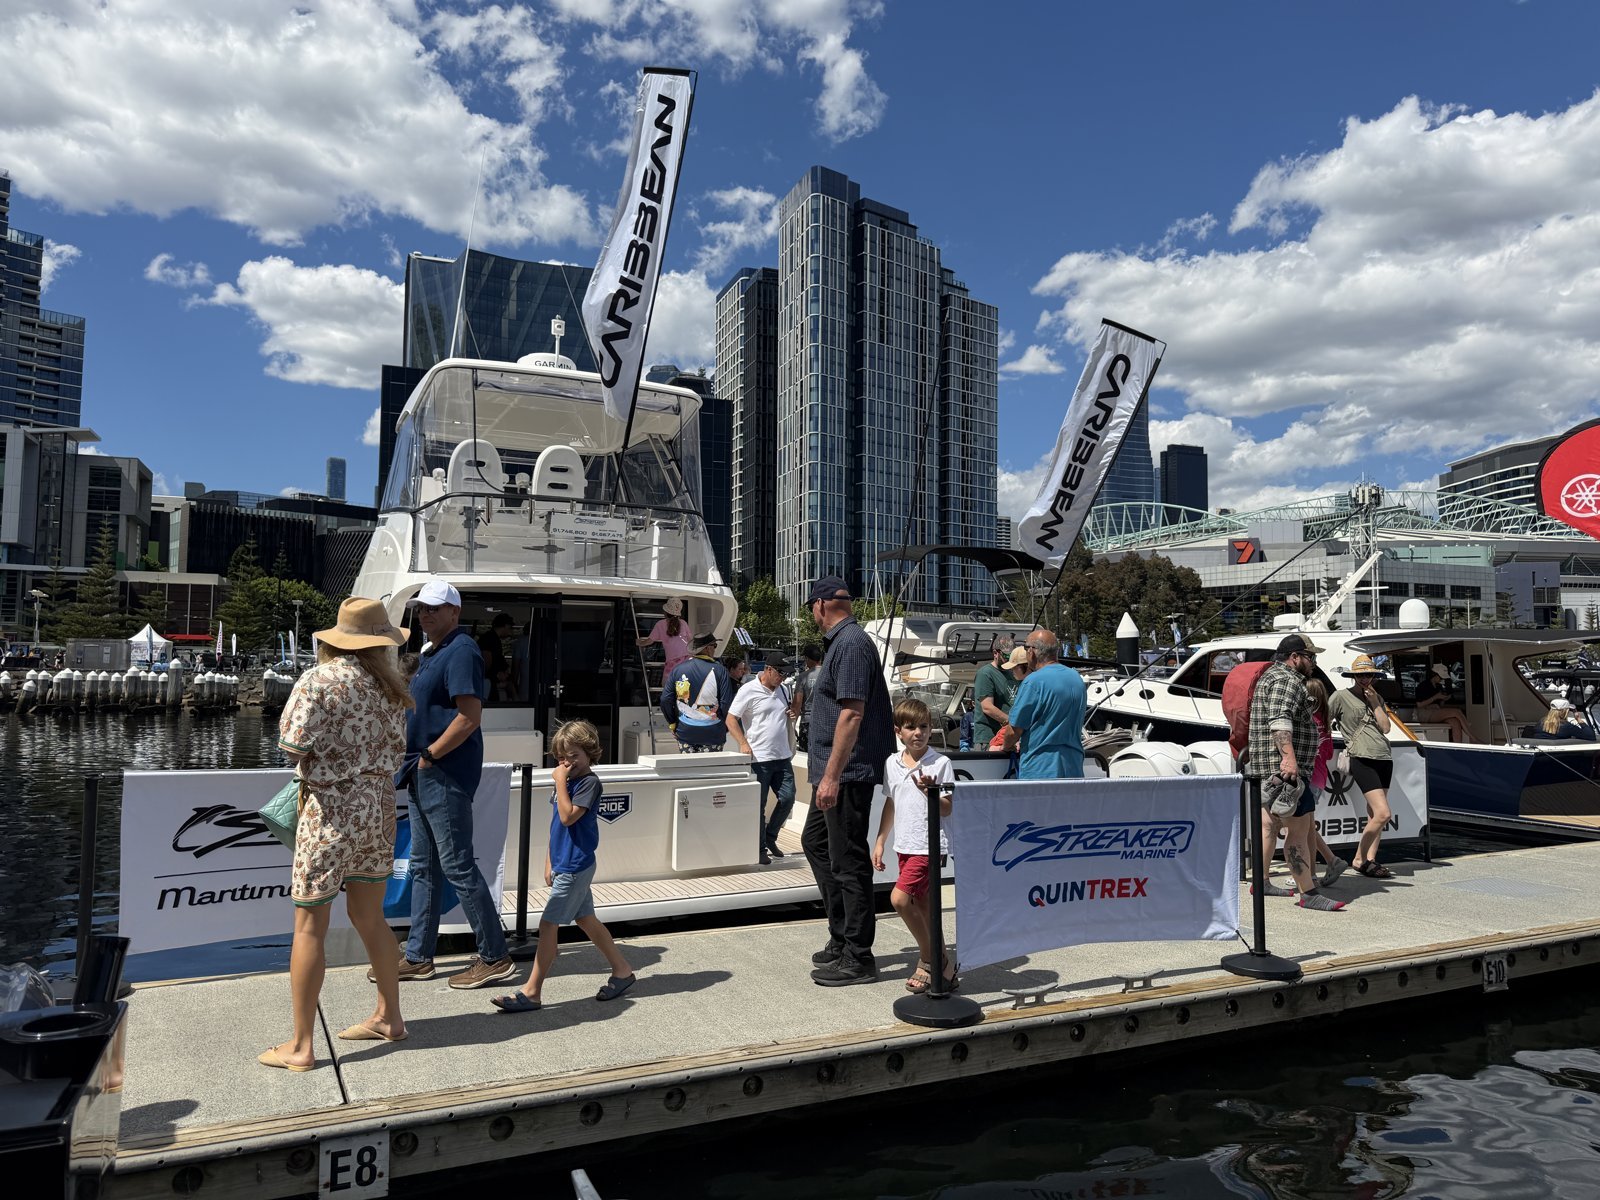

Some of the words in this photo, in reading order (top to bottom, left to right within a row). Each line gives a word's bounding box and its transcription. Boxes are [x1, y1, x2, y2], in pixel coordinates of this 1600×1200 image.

[600, 93, 676, 388] CARIBBEAN
[1036, 353, 1131, 552] CARIBBEAN
[598, 801, 625, 812] RIDE
[1004, 824, 1188, 872] STREAKER
[1120, 849, 1177, 860] MARINE
[156, 884, 293, 910] Maritim
[1028, 877, 1149, 908] QUINTREX
[1486, 960, 1505, 985] E10
[329, 1145, 377, 1193] E8
